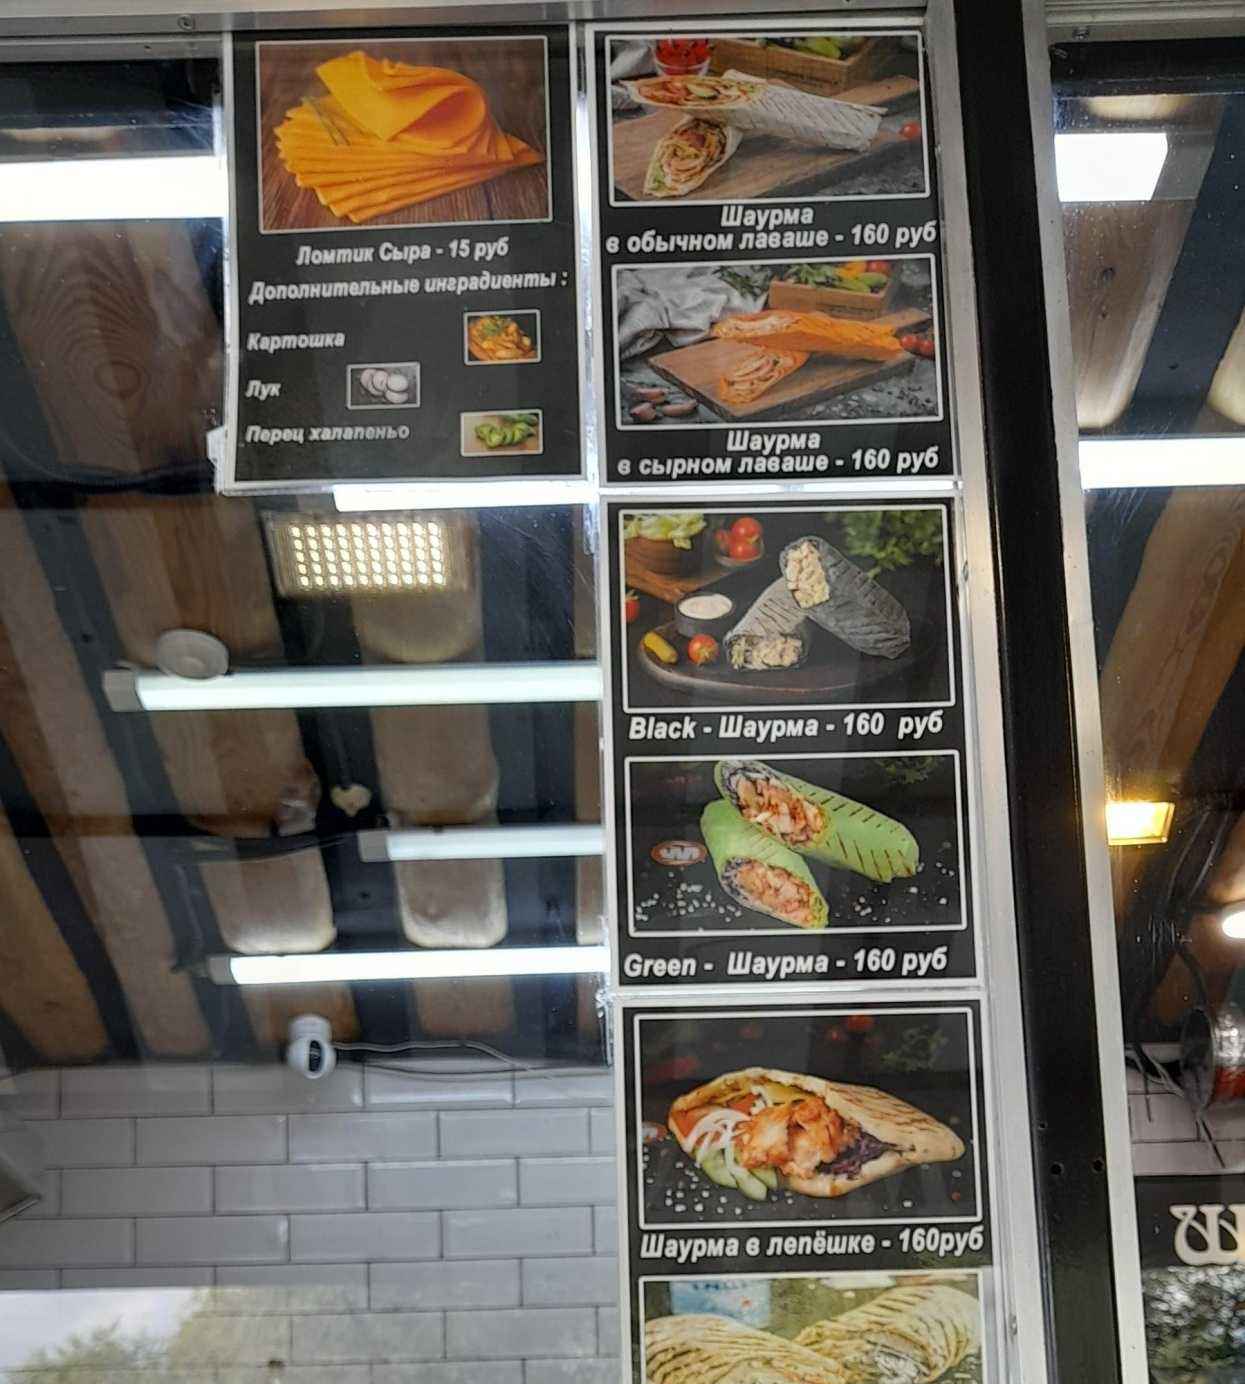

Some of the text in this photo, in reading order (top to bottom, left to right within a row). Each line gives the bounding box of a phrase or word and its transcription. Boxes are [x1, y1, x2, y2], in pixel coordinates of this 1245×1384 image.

[721, 204, 815, 231] Шаурма
[296, 245, 374, 266] Ломтик
[379, 241, 431, 262] Сыра
[449, 239, 470, 258] 15
[473, 236, 510, 260] руб
[605, 235, 620, 254] в
[627, 229, 734, 254] обычном
[738, 229, 830, 250] лаваше
[850, 223, 890, 246] 160
[895, 220, 938, 248] руб
[249, 279, 420, 304] Дополнительные
[425, 271, 557, 295] инградиенты
[247, 332, 346, 353] Картошка
[245, 380, 281, 400] Лук
[245, 425, 410, 445] Перец халапеньо
[726, 429, 821, 454] Шаурма
[617, 458, 631, 475] в
[638, 456, 733, 479] сырном
[737, 453, 829, 474] лаваше
[851, 448, 891, 471] 160
[896, 446, 940, 474] руб
[628, 716, 696, 741] Black
[718, 714, 819, 743] Шаурма
[843, 712, 885, 736] 160
[897, 710, 944, 740] руб
[623, 953, 698, 978] Green
[727, 951, 829, 979] Шаурма
[853, 948, 896, 972] 160
[901, 946, 948, 976] руб
[640, 1233, 739, 1264] Шаурма
[745, 1238, 761, 1256] в
[765, 1229, 876, 1257] лепёшке
[899, 1225, 985, 1257] 160руб
